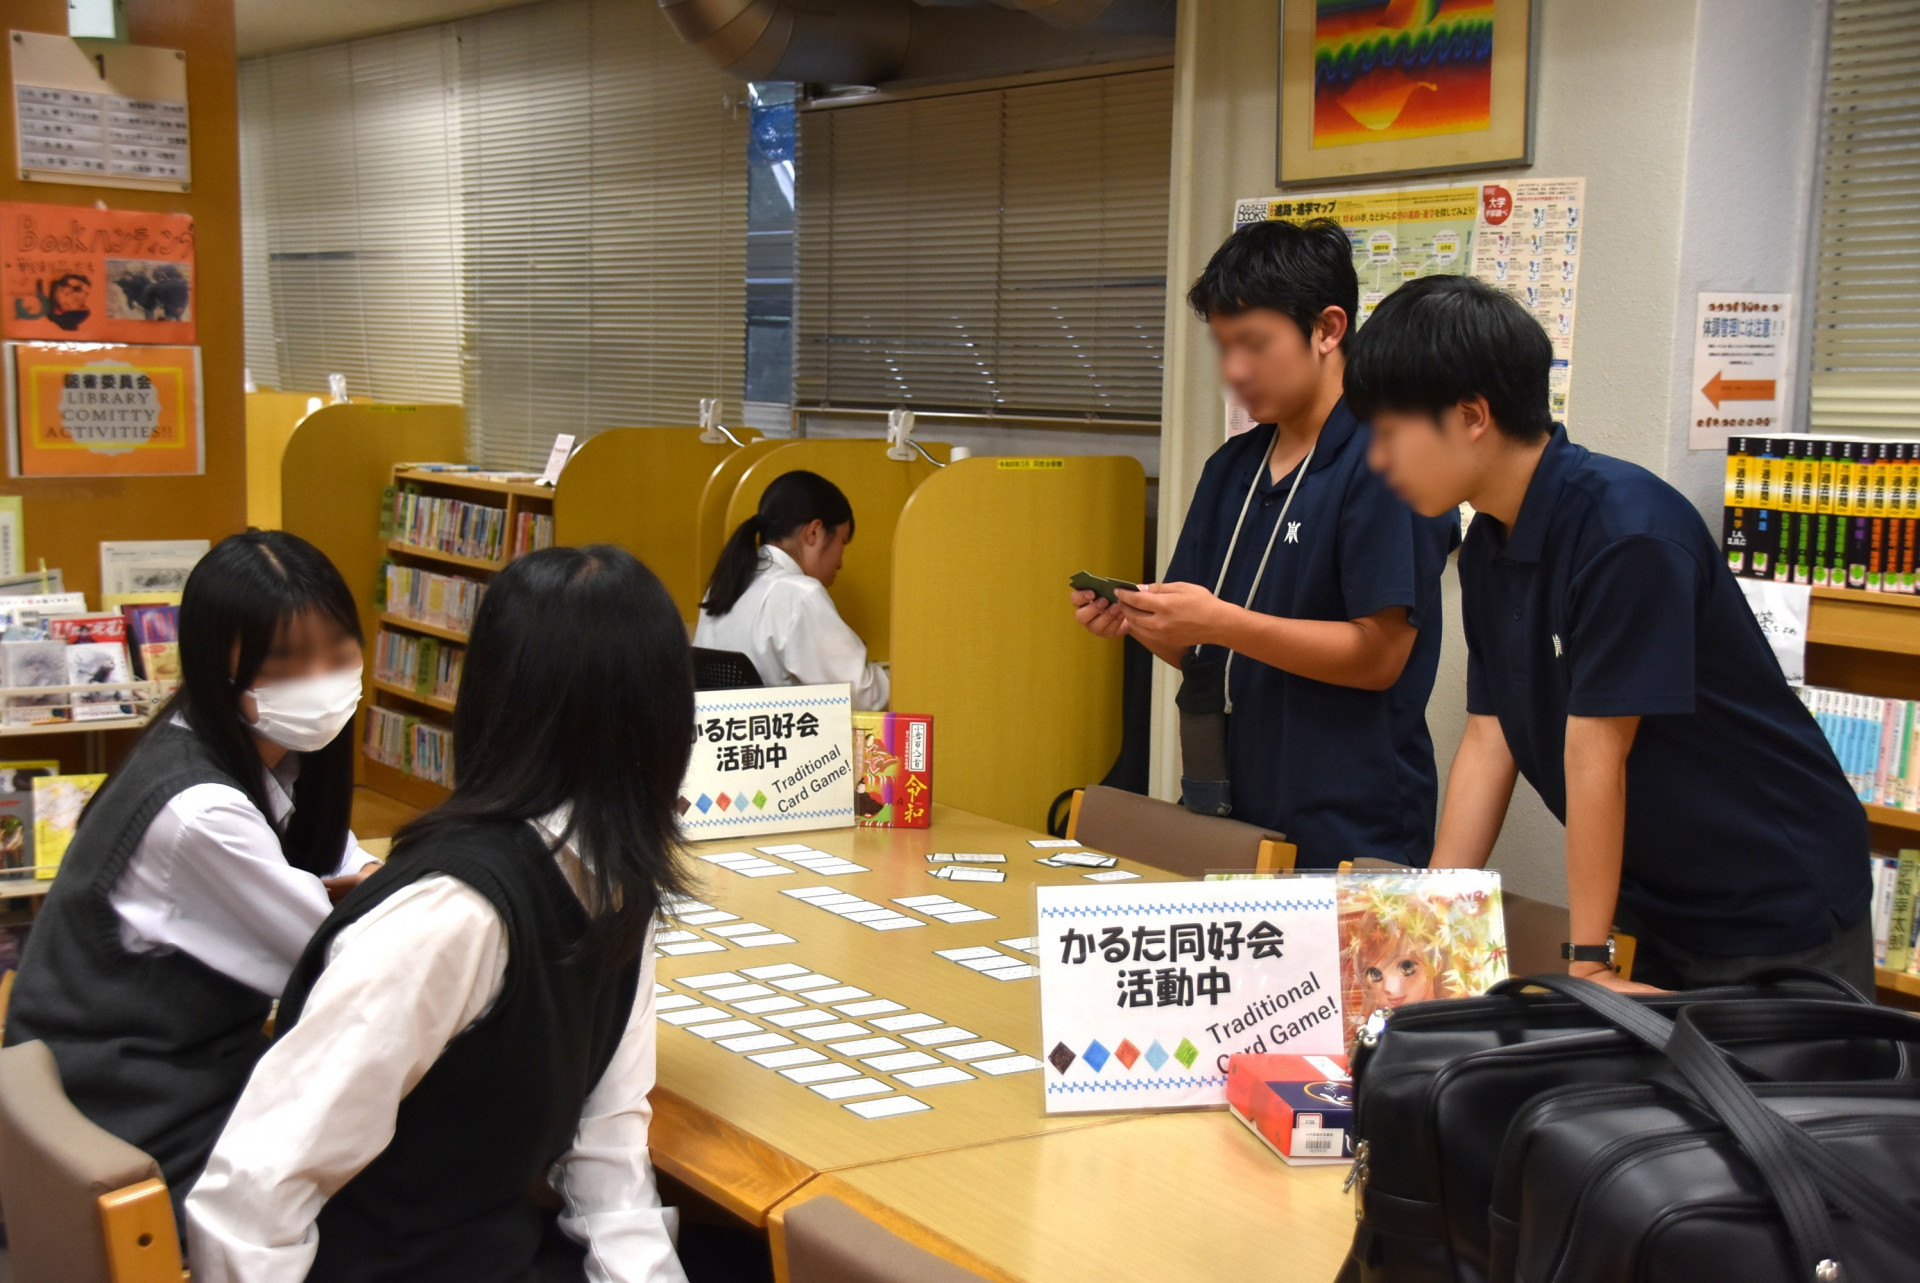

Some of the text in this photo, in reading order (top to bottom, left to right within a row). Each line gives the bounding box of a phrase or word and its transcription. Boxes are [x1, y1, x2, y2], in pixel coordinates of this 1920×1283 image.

[95, 53, 106, 80] 1
[1488, 197, 1506, 208] 大学
[62, 409, 156, 422] COMITTY
[67, 392, 150, 405] LIBRARY
[47, 426, 172, 439] ACTIVITIES!!
[717, 742, 787, 772] 活動中
[772, 744, 841, 795] Traditional
[777, 759, 852, 814] Card Game!
[905, 774, 927, 823] 令和
[1060, 920, 1284, 965] かるた同好会
[1117, 966, 1232, 1008] 活動中
[1206, 971, 1321, 1045] Traditional
[1269, 995, 1340, 1047] Game!
